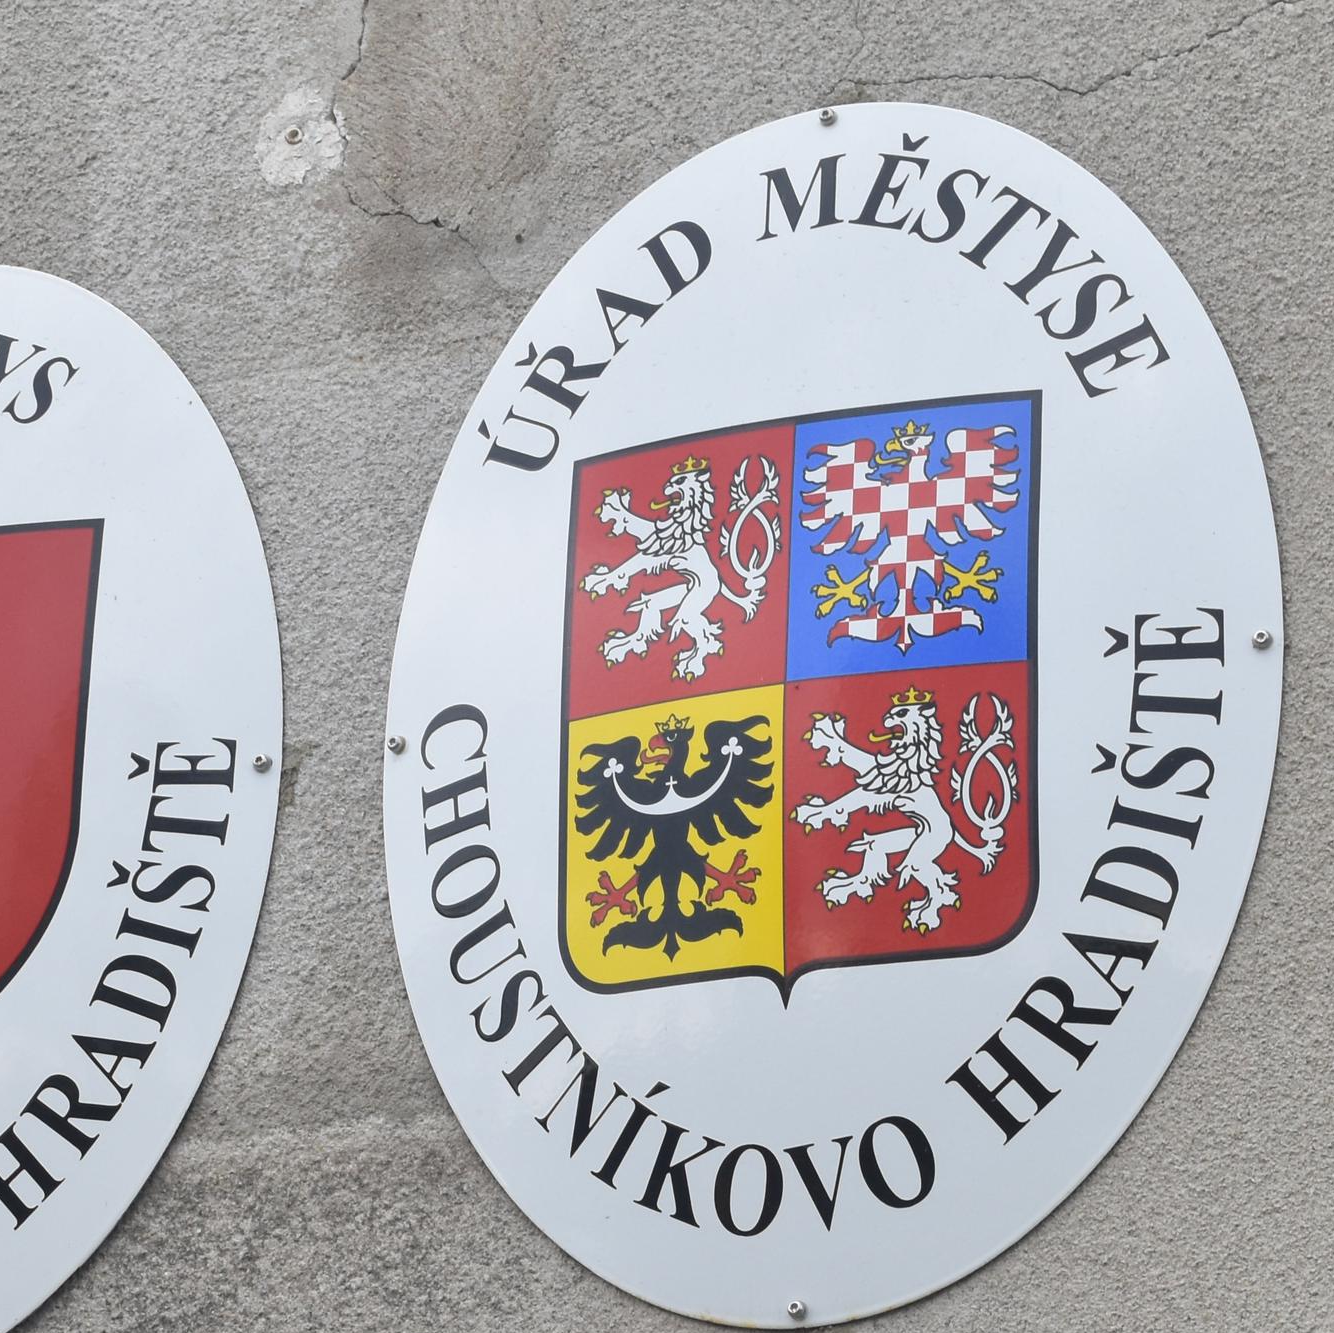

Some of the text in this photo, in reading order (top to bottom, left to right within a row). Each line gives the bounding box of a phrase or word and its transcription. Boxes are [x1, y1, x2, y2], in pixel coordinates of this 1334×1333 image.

[476, 130, 1171, 478] ÚŘAD MĚSTYSE
[418, 606, 1227, 1240] CHOUSTNÍKOVO HRADIŠTĚ
